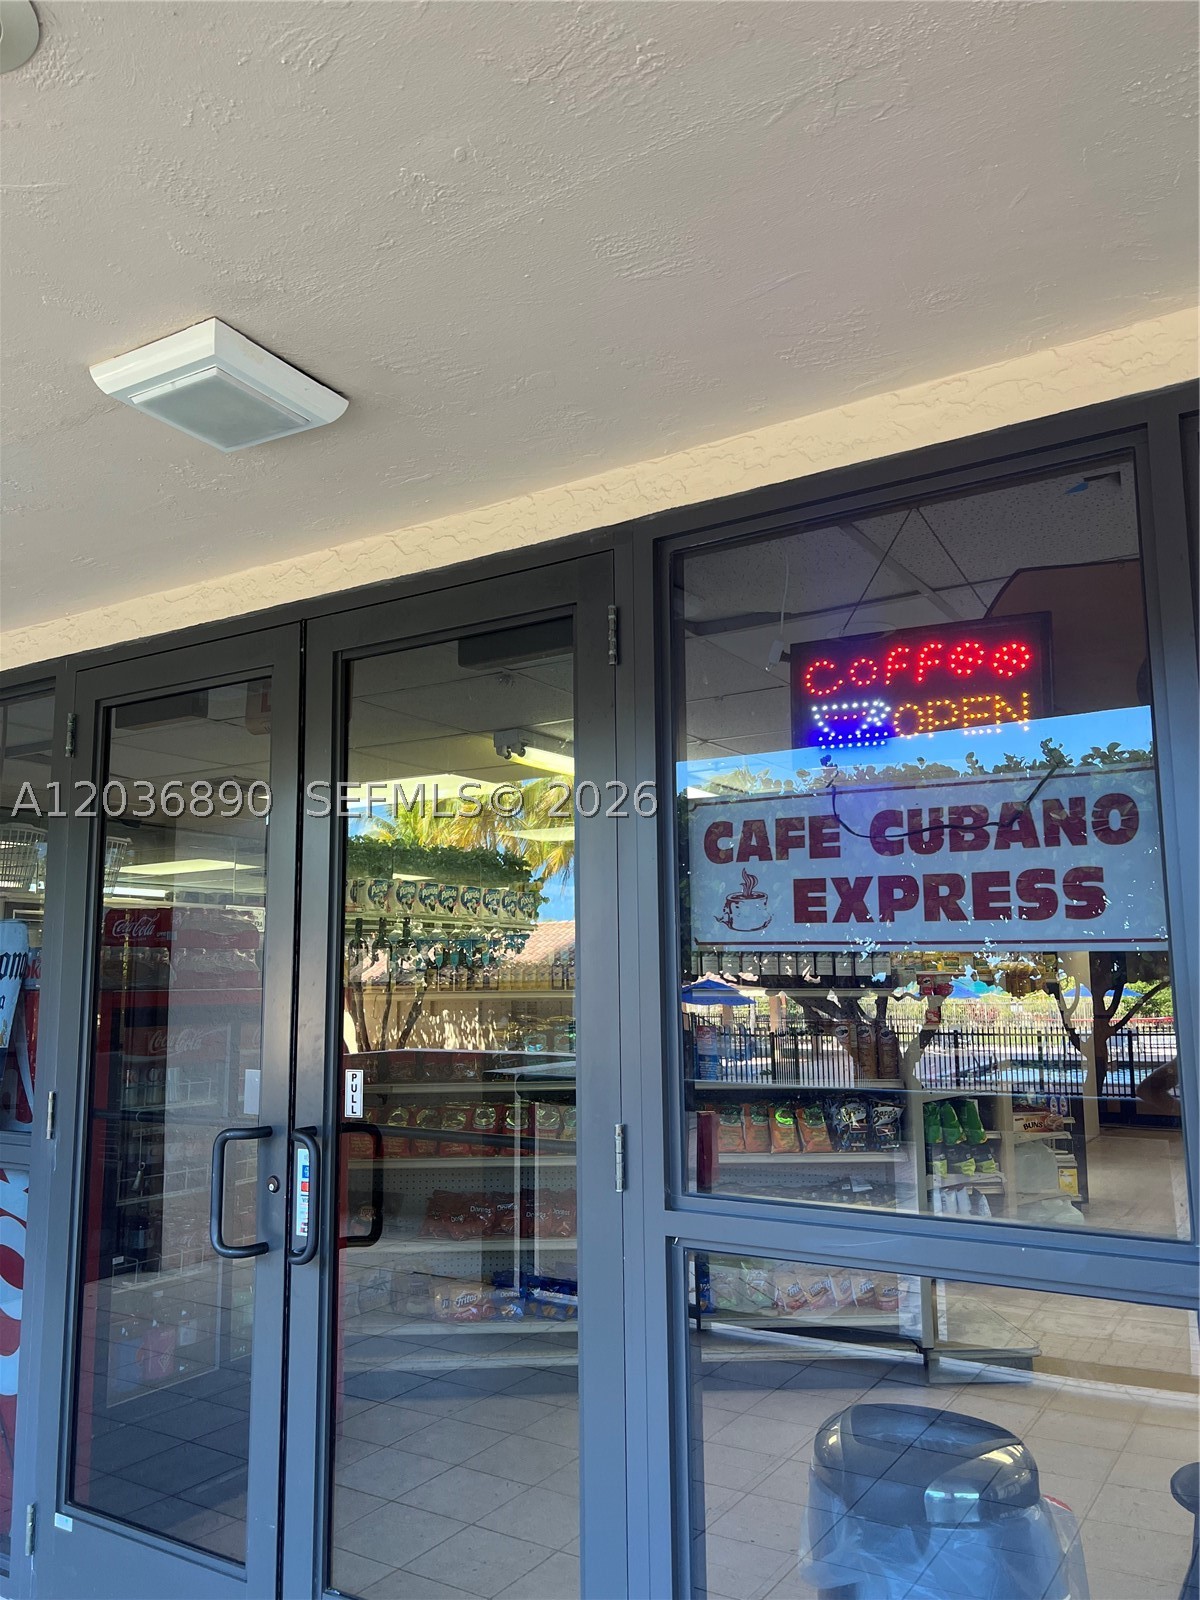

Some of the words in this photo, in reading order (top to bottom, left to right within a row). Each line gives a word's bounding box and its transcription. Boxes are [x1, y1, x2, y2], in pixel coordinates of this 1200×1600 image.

[893, 692, 1031, 741] OPEN
[703, 814, 841, 864] CAFE
[868, 792, 1141, 857] CUBANO
[793, 866, 1108, 924] EXPRESS
[350, 1072, 358, 1115] PULL
[1022, 1121, 1044, 1131] BUNS
